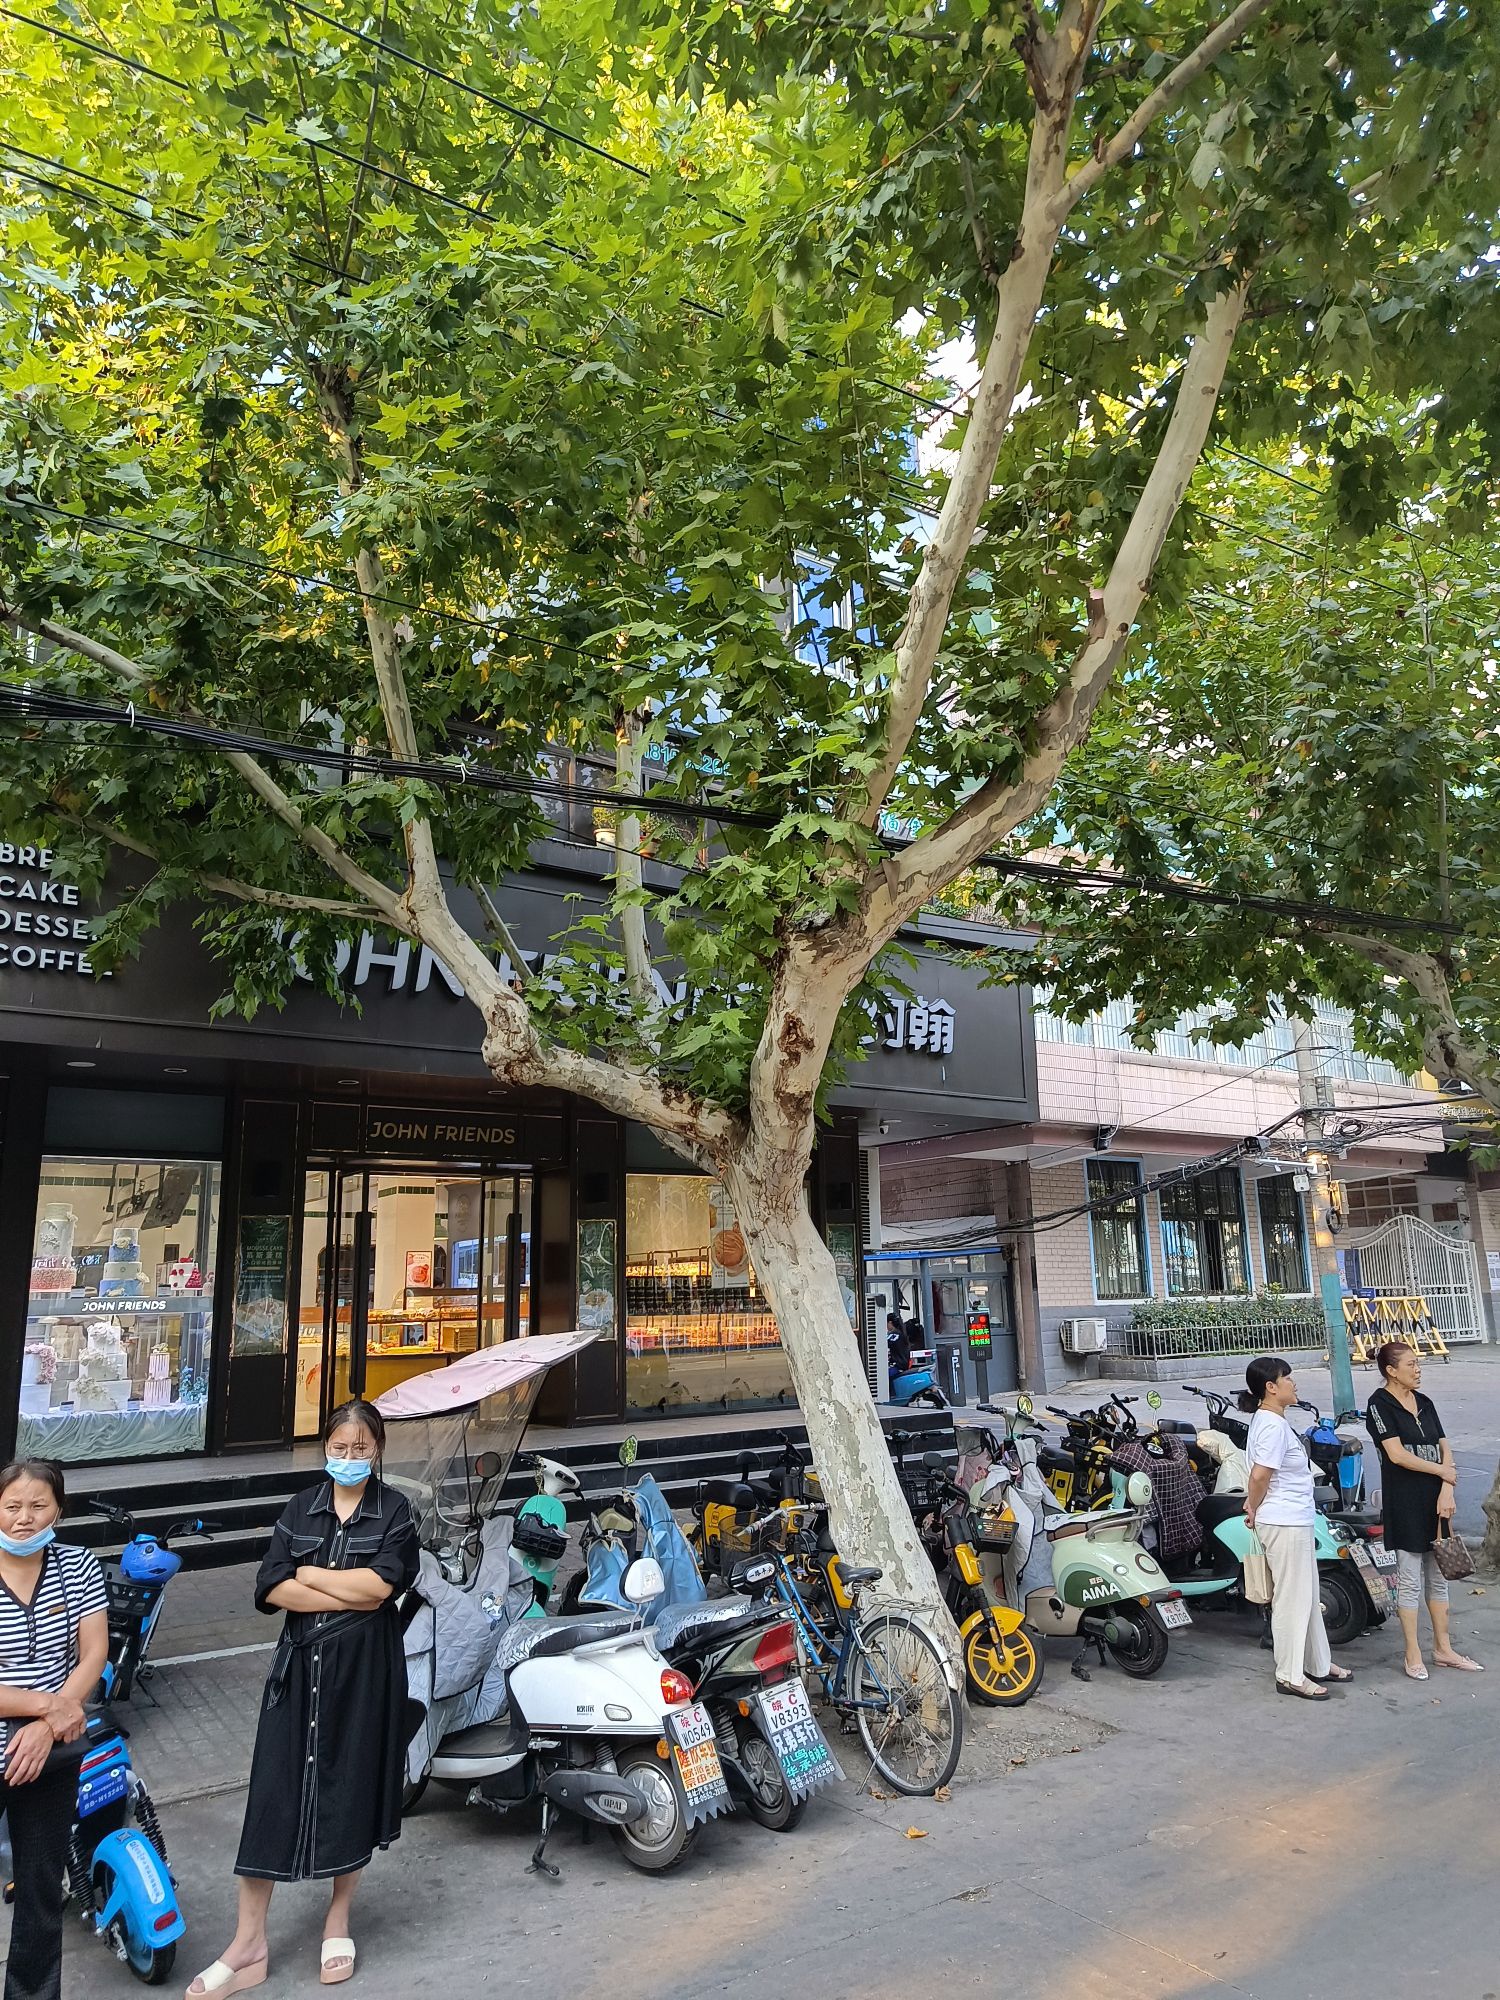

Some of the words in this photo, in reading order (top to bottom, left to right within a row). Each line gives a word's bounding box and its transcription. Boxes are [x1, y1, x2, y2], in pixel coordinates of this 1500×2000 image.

[0, 875, 79, 906] CAKE
[271, 916, 466, 998] OHN
[370, 1121, 428, 1140] JOHN
[434, 1125, 516, 1145] FRIENDS
[82, 1302, 116, 1312] JOHN
[117, 1301, 167, 1311] FRIENDS
[1082, 1582, 1121, 1602] AIMA
[788, 1693, 798, 1706] C
[693, 1711, 703, 1723] C
[770, 1703, 808, 1730] V8393
[681, 1721, 712, 1747] W0549
[771, 1718, 819, 1758] 兄弟车行
